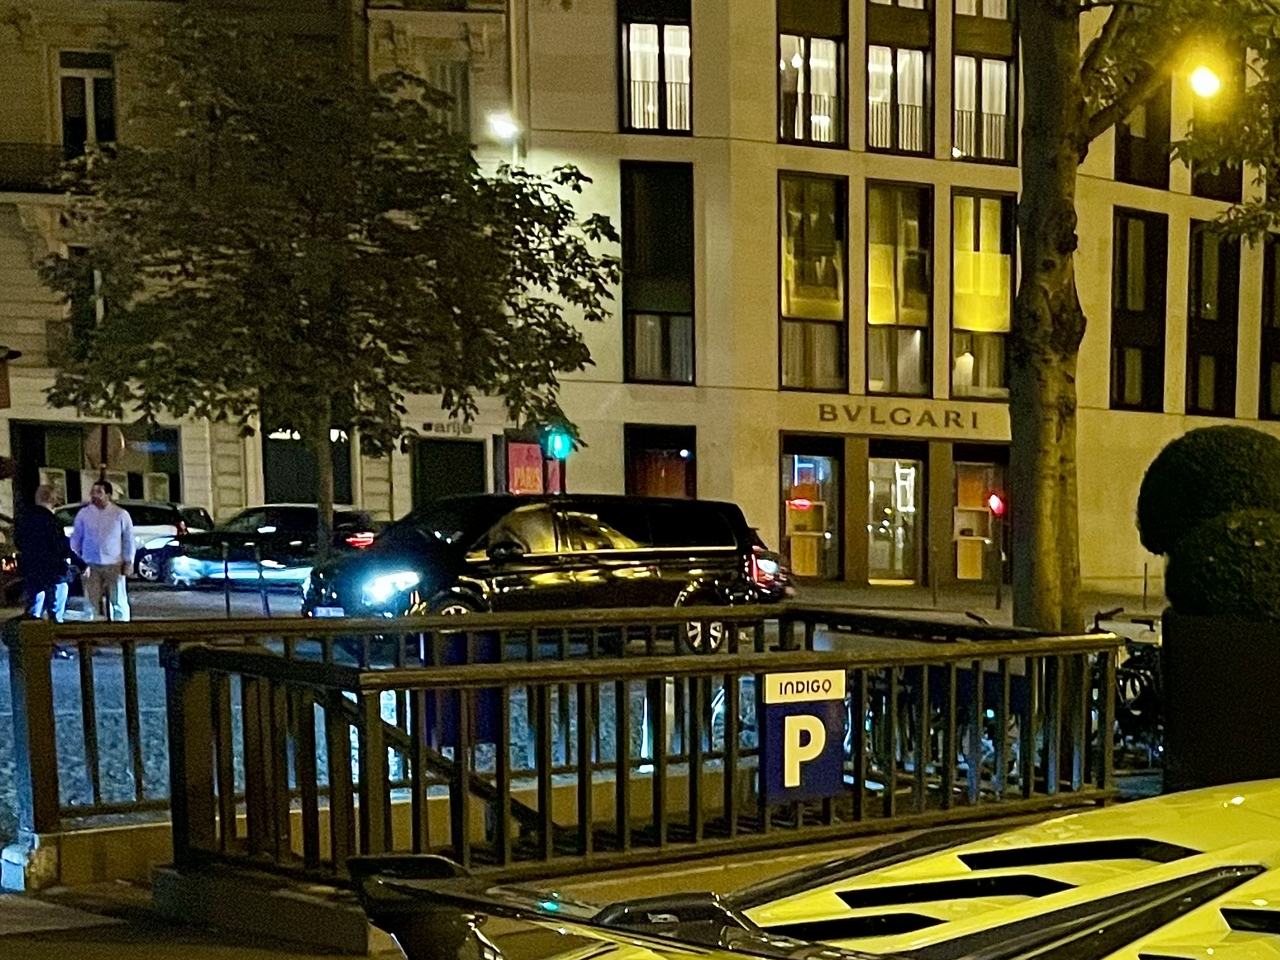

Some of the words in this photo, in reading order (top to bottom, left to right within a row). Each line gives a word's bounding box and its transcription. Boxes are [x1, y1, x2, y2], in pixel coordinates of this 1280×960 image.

[818, 403, 979, 429] BVLGARI
[780, 679, 832, 695] INDIGO
[784, 714, 827, 788] P
